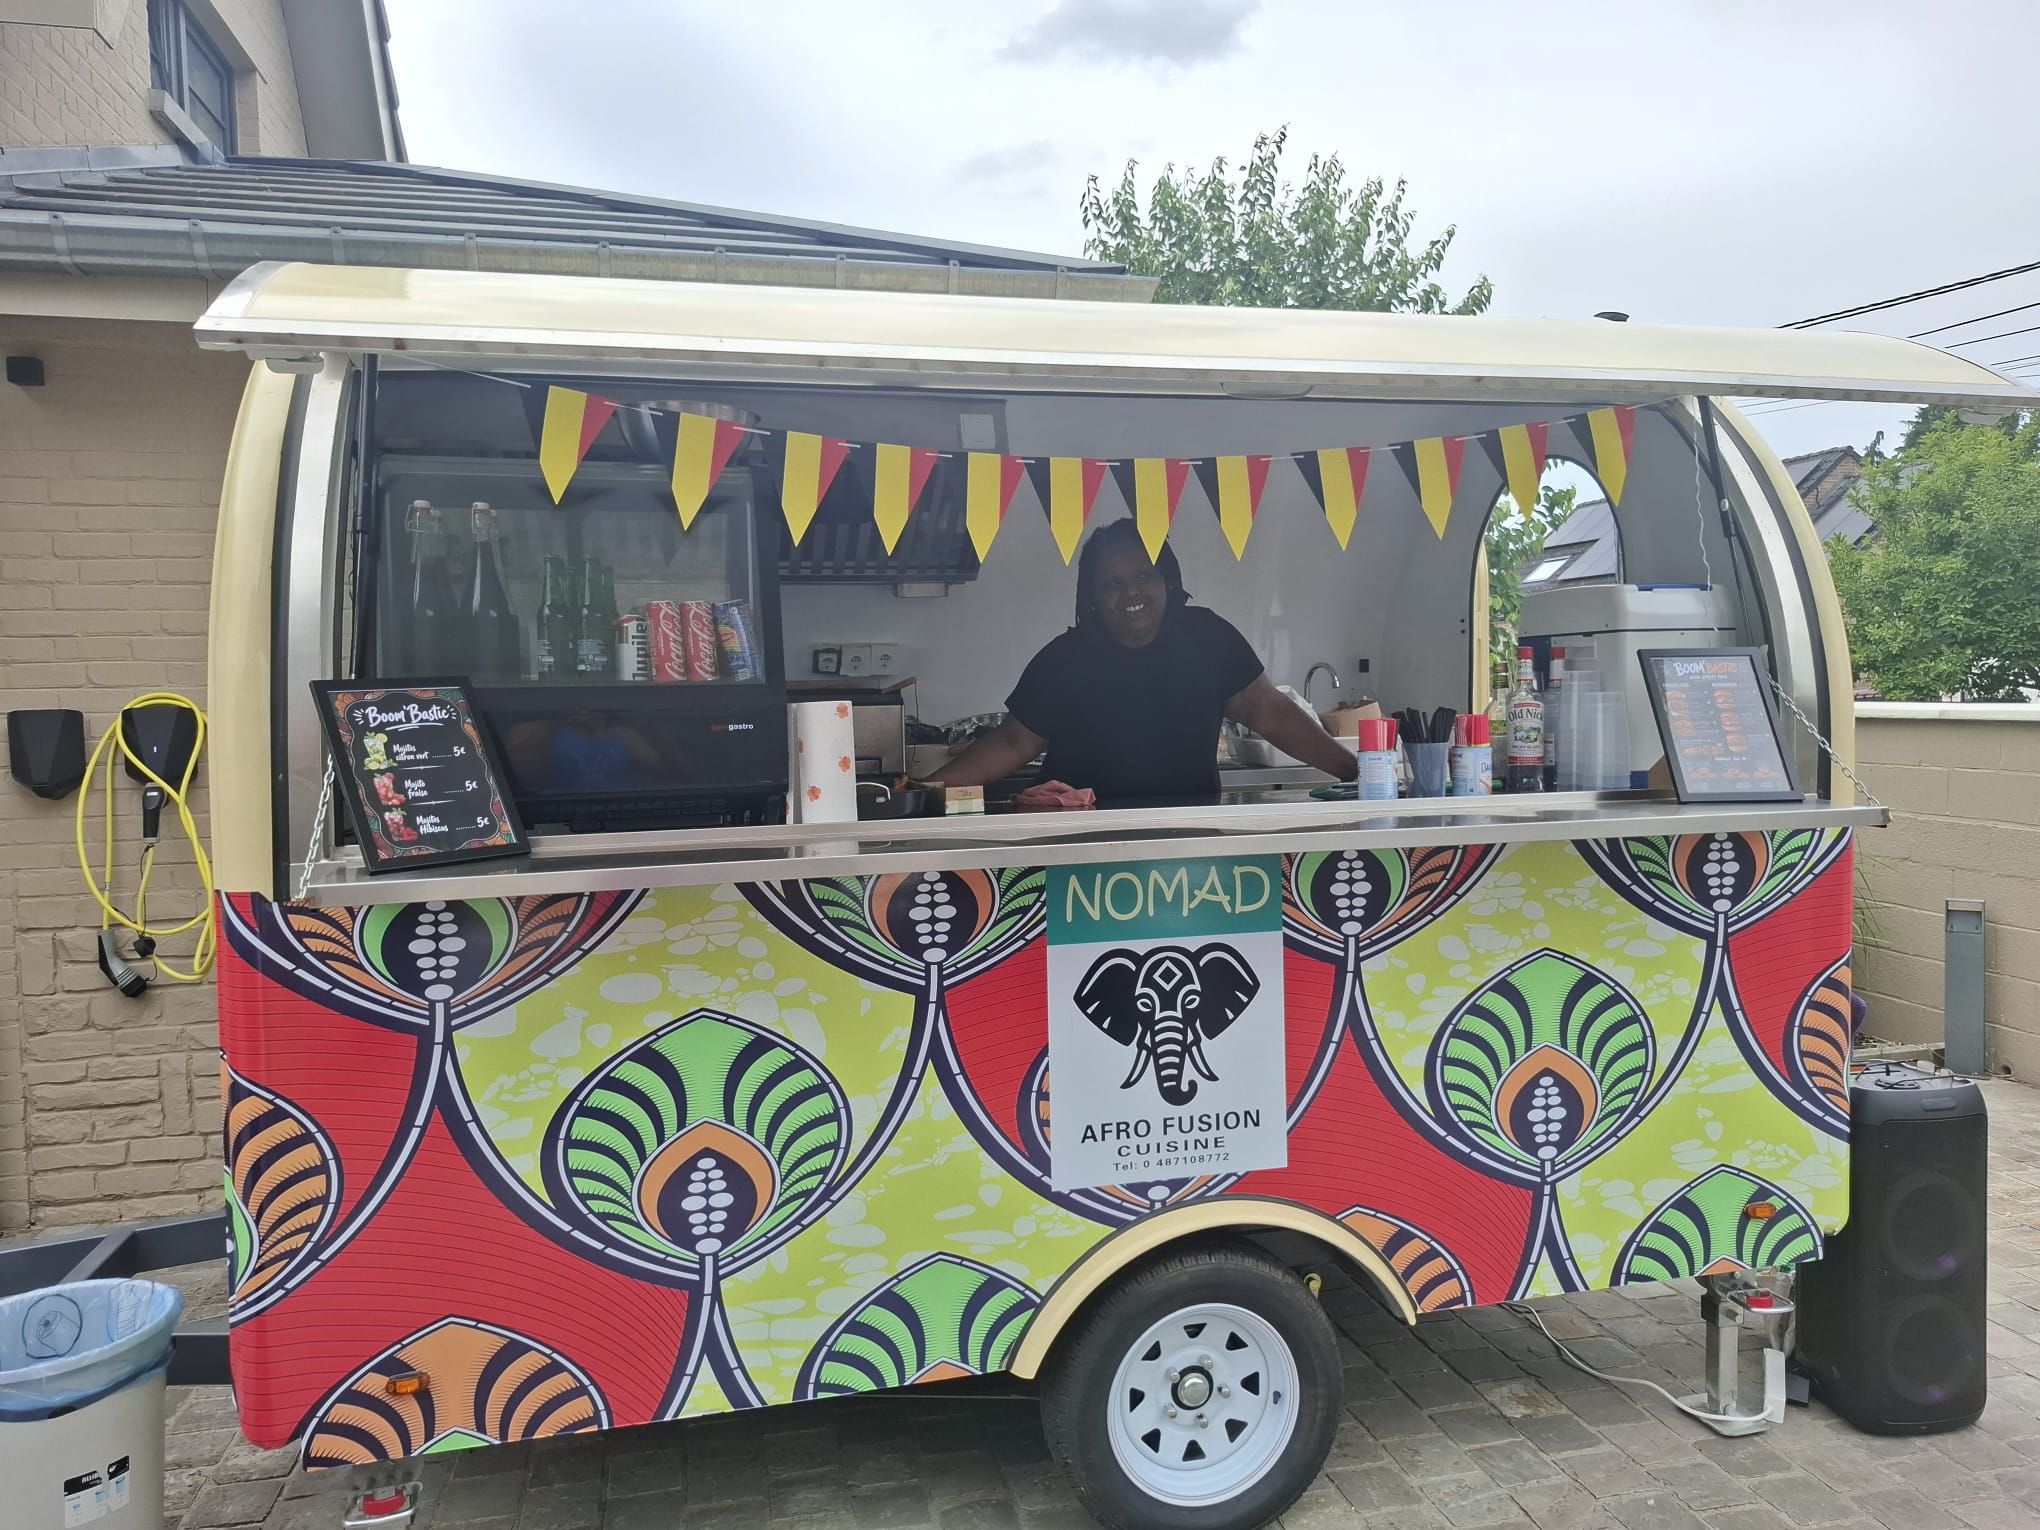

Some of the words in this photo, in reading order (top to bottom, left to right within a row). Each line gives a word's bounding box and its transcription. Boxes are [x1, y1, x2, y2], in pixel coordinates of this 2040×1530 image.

[1508, 708, 1524, 722] Old
[416, 751, 430, 760] vert
[453, 746, 466, 757] 5€
[404, 779, 426, 790] Mojito
[465, 780, 478, 792] 5€
[408, 788, 428, 800] fraise
[416, 814, 441, 826] Mojitos
[476, 816, 490, 828] 5€
[419, 824, 449, 835] Hibiscus
[1066, 865, 1270, 923] NOMAD
[1080, 1119, 1152, 1144] AFRO
[1162, 1109, 1261, 1136] FUSION
[1117, 1136, 1226, 1157] CUISINE
[1113, 1161, 1138, 1172] Tel:
[1143, 1160, 1150, 1168] 0
[1156, 1152, 1230, 1167] 487108772
